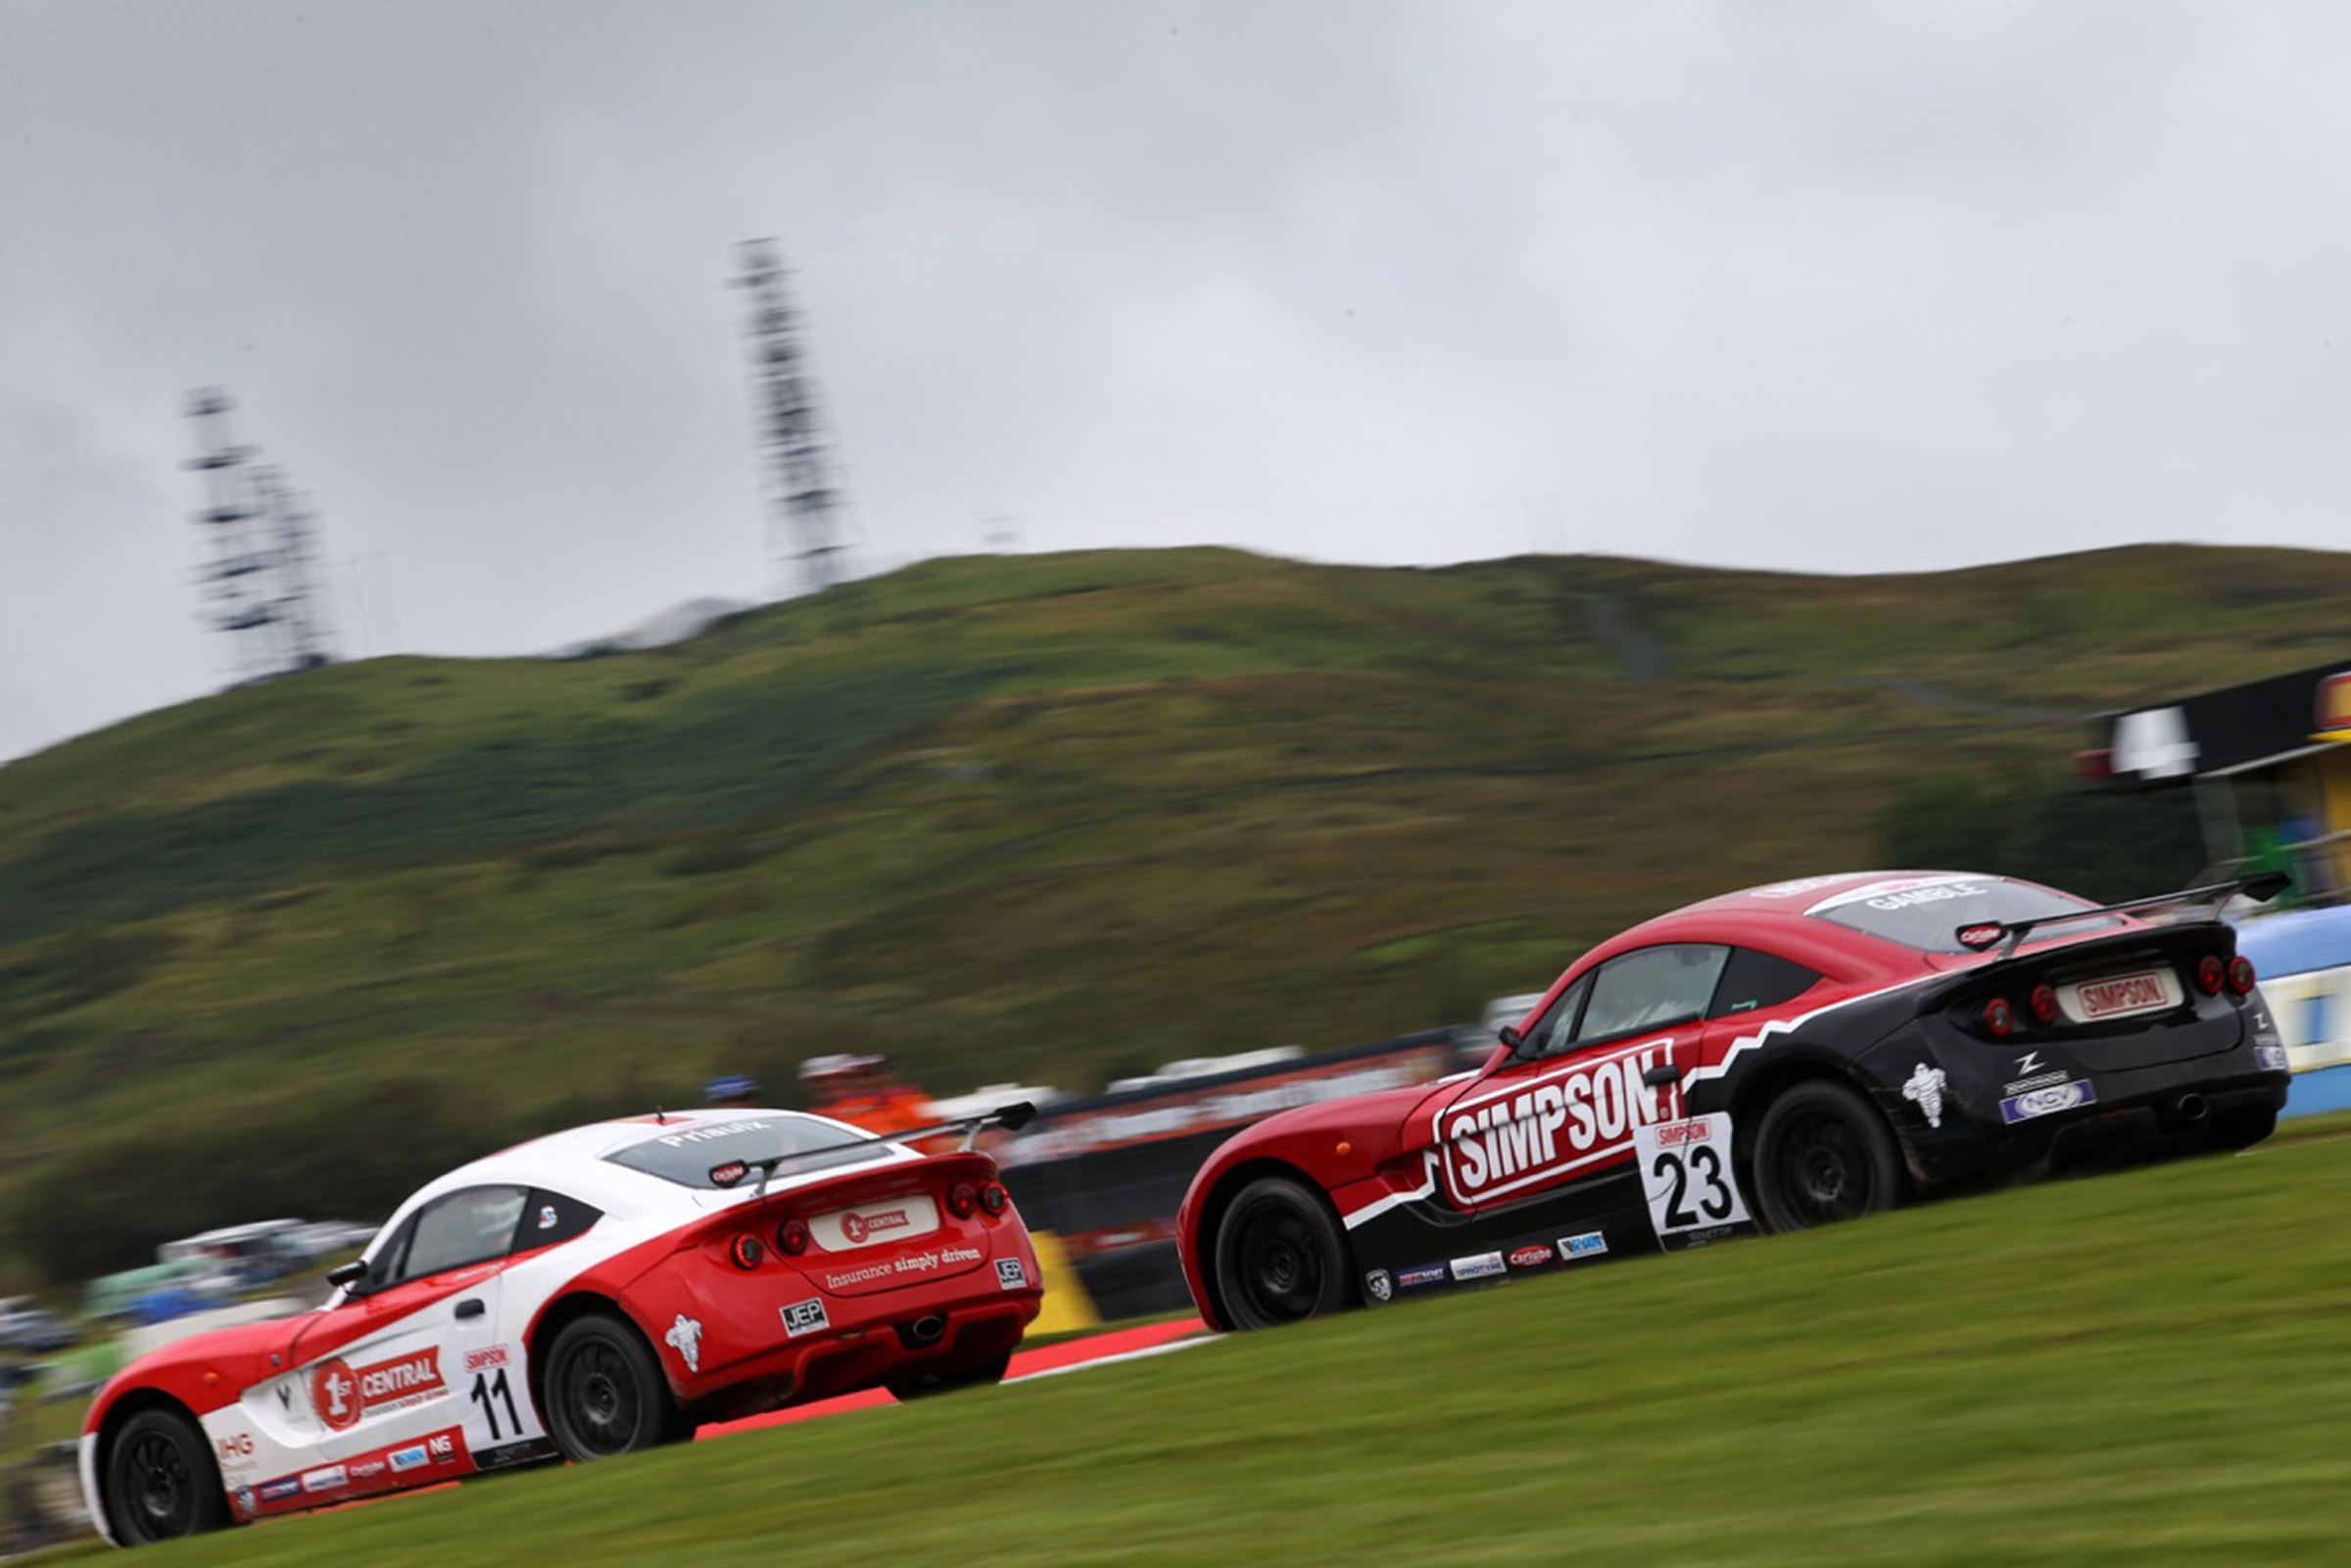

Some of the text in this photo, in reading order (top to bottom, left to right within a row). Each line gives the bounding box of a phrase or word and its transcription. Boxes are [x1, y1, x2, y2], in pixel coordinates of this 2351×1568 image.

[1867, 882, 1988, 910] GAMBLE
[2084, 976, 2161, 1013] SIMPSON
[1451, 1050, 1658, 1189] SIMPSON
[1658, 1122, 1706, 1145] SIMPSON
[1654, 1145, 1733, 1229] 23
[869, 1212, 905, 1230] CENTRAL
[827, 1248, 981, 1289] Insurance simply driven
[1001, 1259, 1021, 1280] JEP
[788, 1303, 821, 1327] JEP
[362, 1357, 437, 1398] CENTRAL
[470, 1368, 524, 1441] 11
